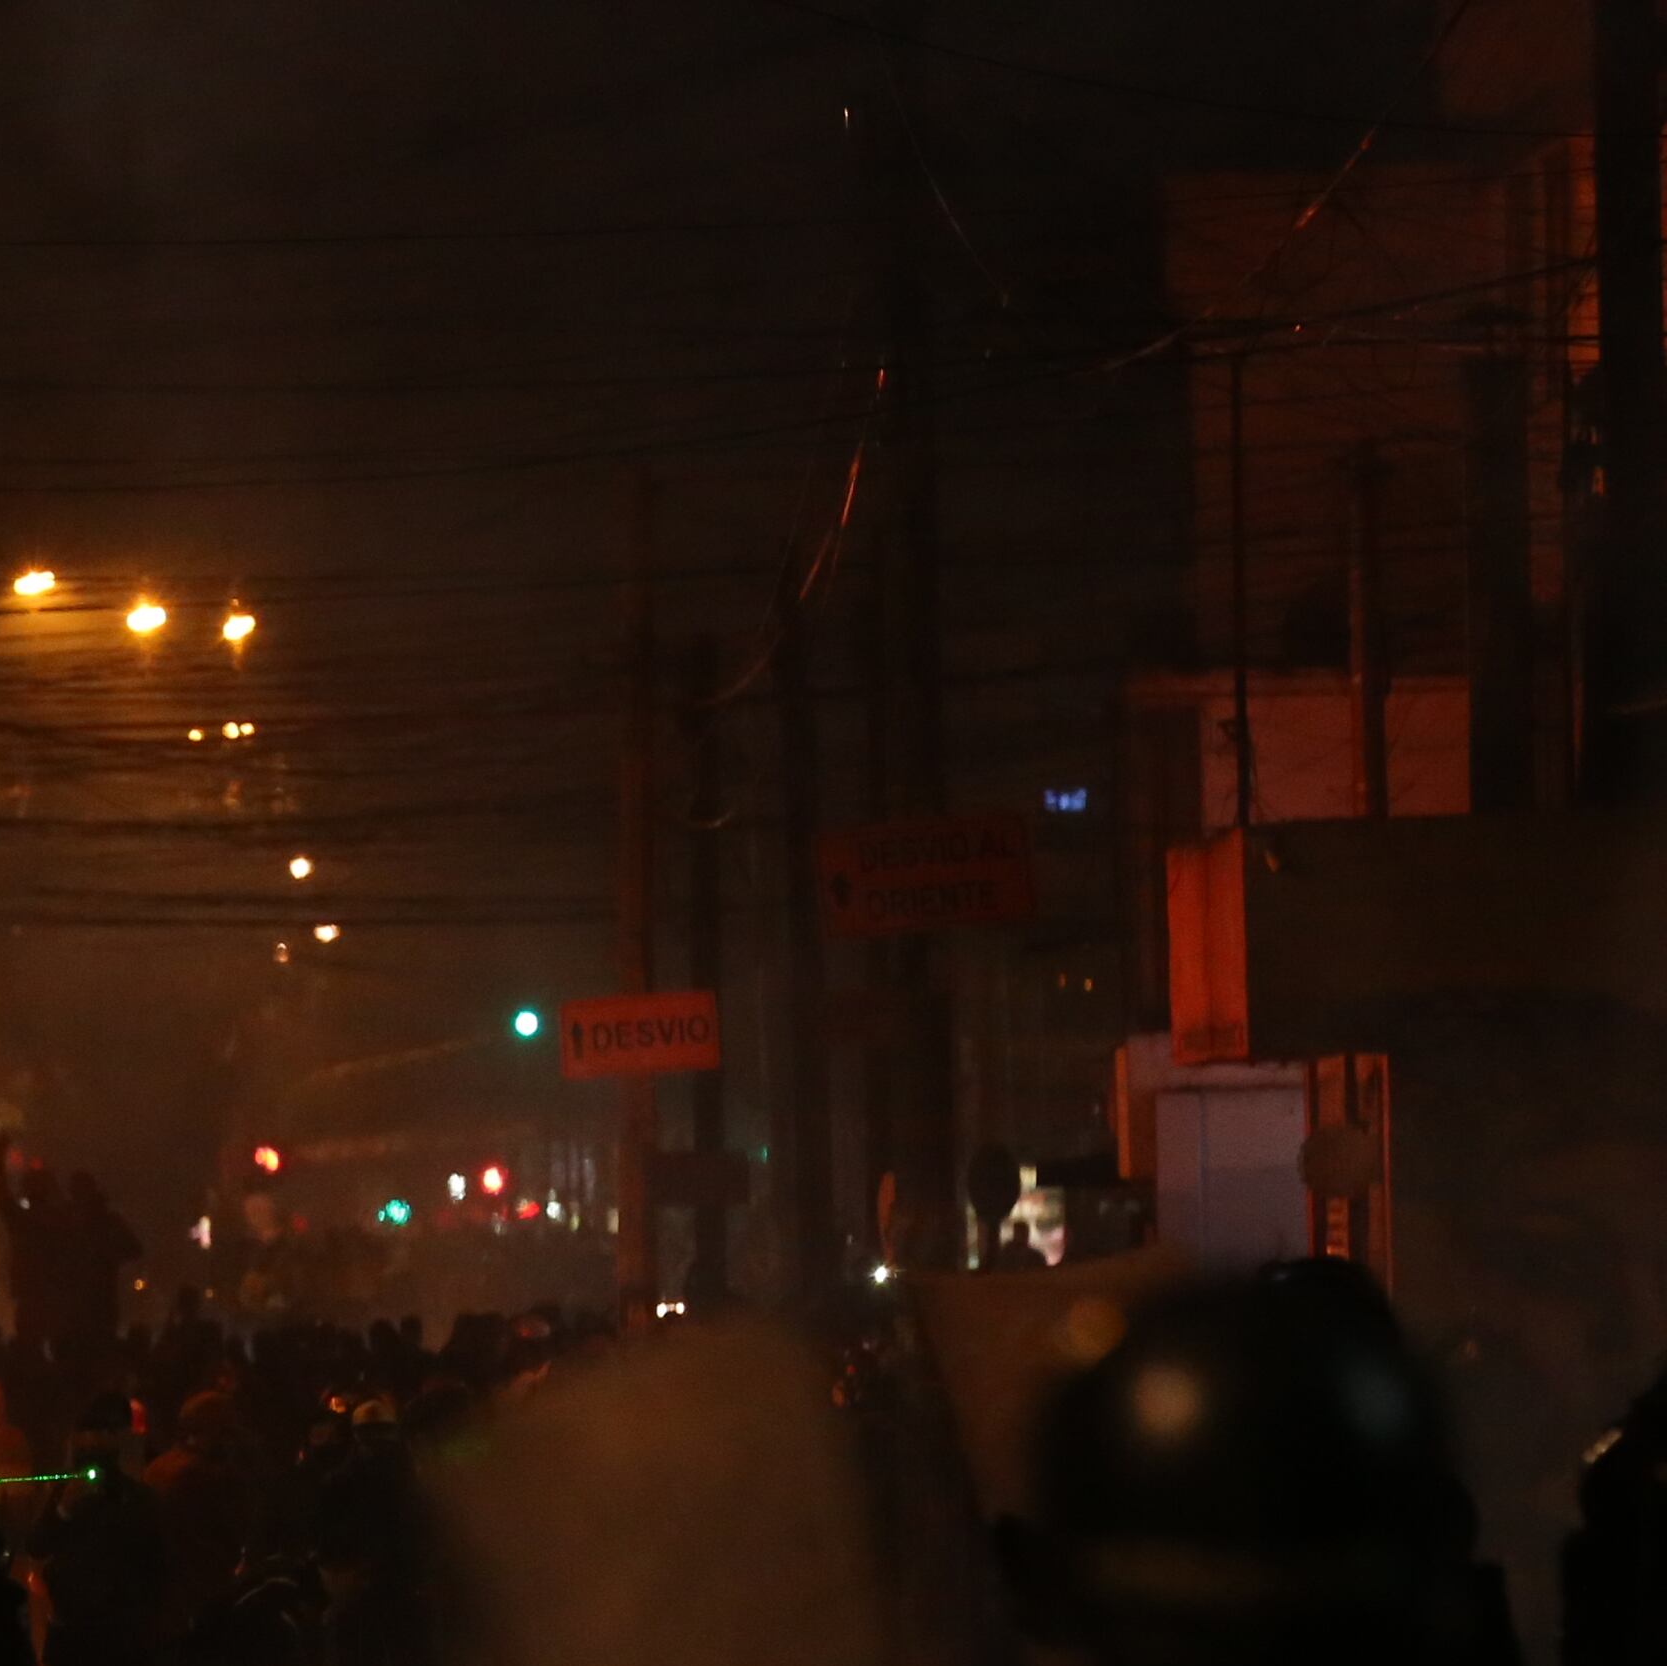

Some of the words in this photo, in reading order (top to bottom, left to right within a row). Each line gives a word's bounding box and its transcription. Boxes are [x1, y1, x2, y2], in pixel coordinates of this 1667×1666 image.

[858, 831, 969, 873] DESVIO
[979, 826, 1017, 858] AL
[867, 879, 997, 920] ORIENTE
[590, 1013, 711, 1056] DESVIO
